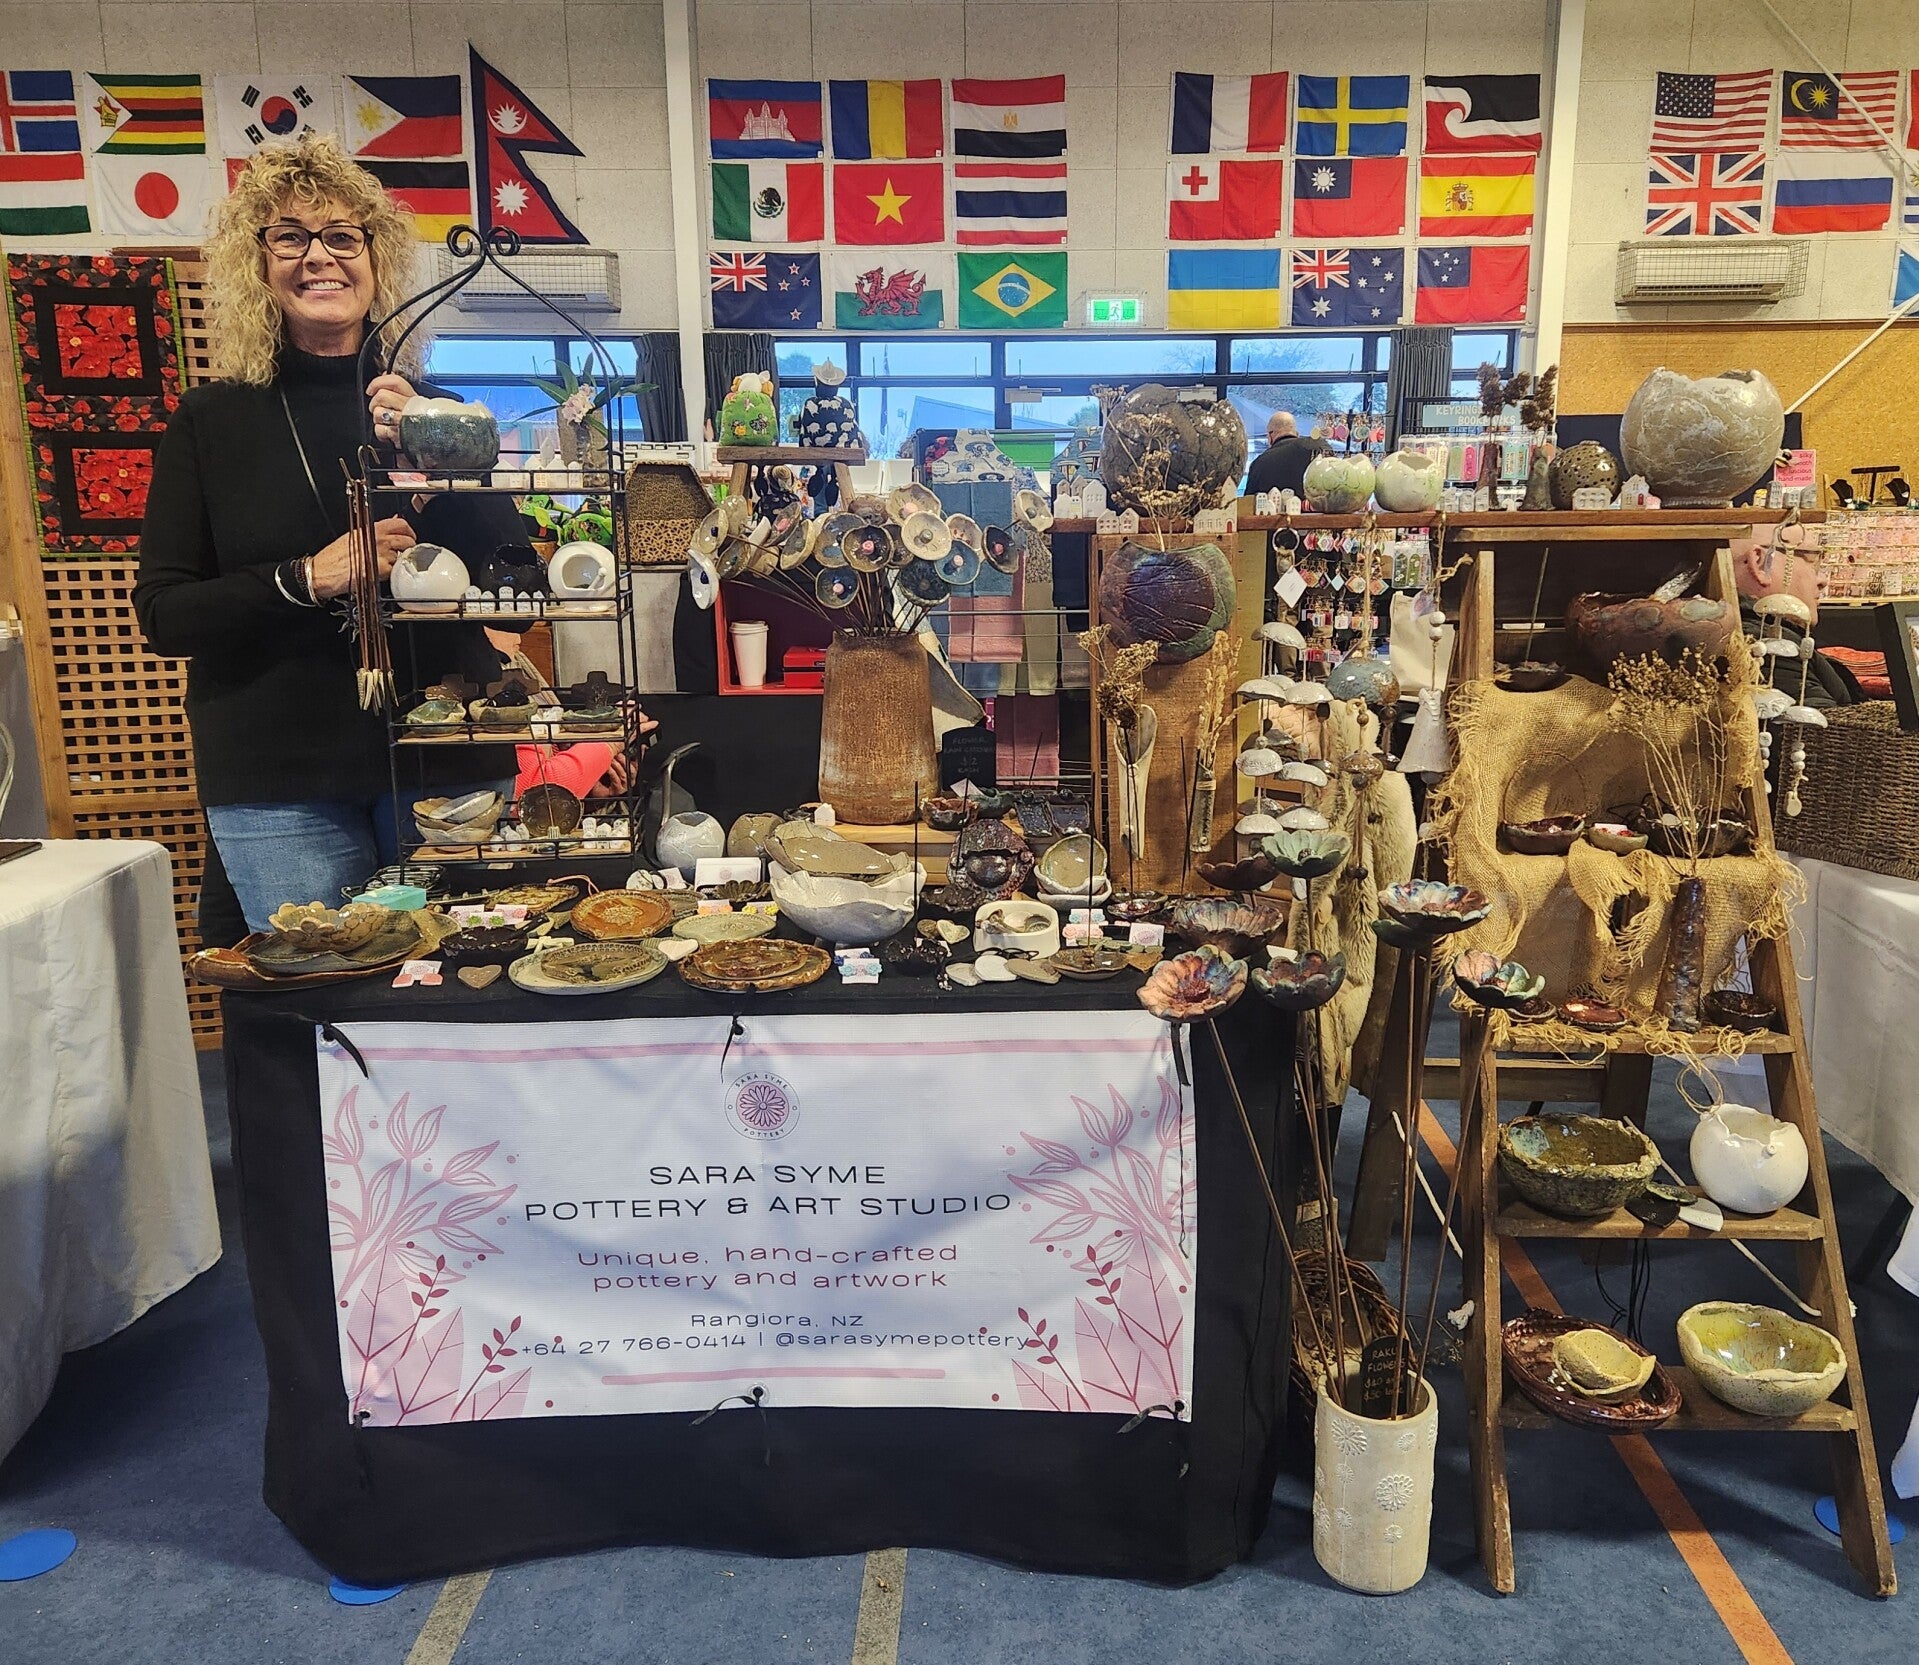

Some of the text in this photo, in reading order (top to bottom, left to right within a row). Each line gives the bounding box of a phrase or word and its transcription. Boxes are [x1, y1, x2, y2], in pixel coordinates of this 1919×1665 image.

[764, 1074, 788, 1089] SYME
[744, 1128, 785, 1138] POTTERY
[649, 1165, 886, 1185] SARA SYME
[525, 1194, 1011, 1222] POTTERY & ART STUDIO
[725, 1245, 957, 1264] hand-crafted
[594, 1271, 948, 1292] pottery and artwork
[691, 1313, 864, 1328] Rangiora, NZ
[522, 1343, 566, 1356] +64
[579, 1340, 611, 1355] 27
[622, 1335, 747, 1351] 766-0414
[775, 1331, 1029, 1350] @sarasymepottery
[1367, 1358, 1406, 1372] FLOWES
